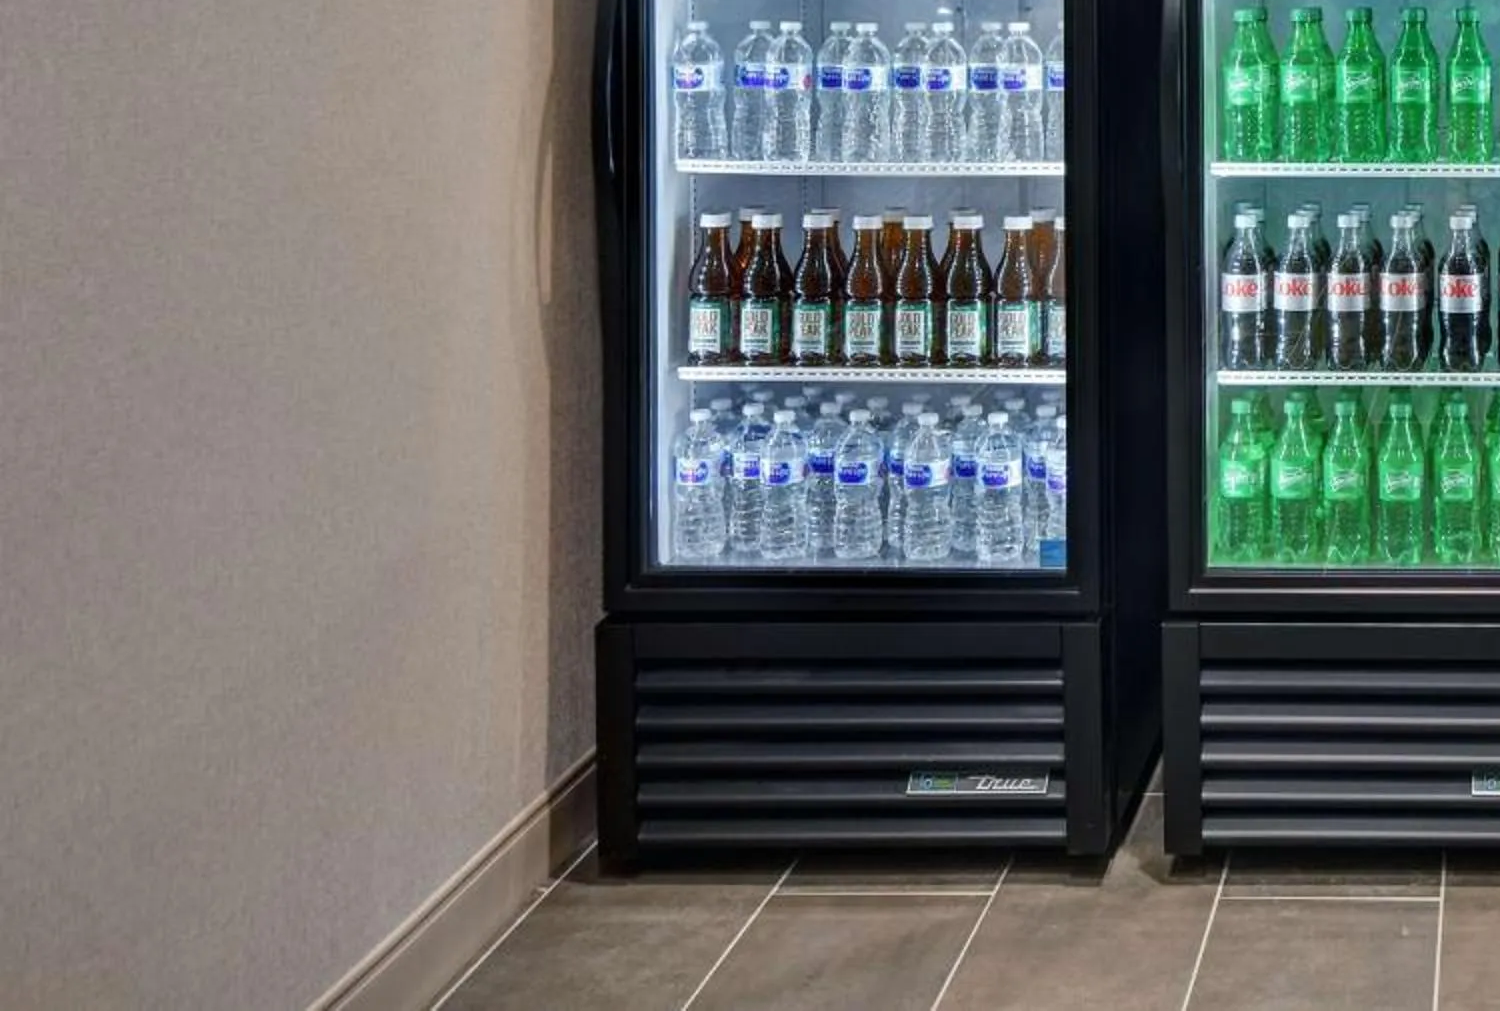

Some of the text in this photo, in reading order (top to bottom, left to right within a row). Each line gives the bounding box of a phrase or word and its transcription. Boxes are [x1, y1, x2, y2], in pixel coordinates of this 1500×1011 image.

[1224, 278, 1258, 298] oke
[1276, 277, 1311, 297] oke
[967, 774, 1038, 791] True
